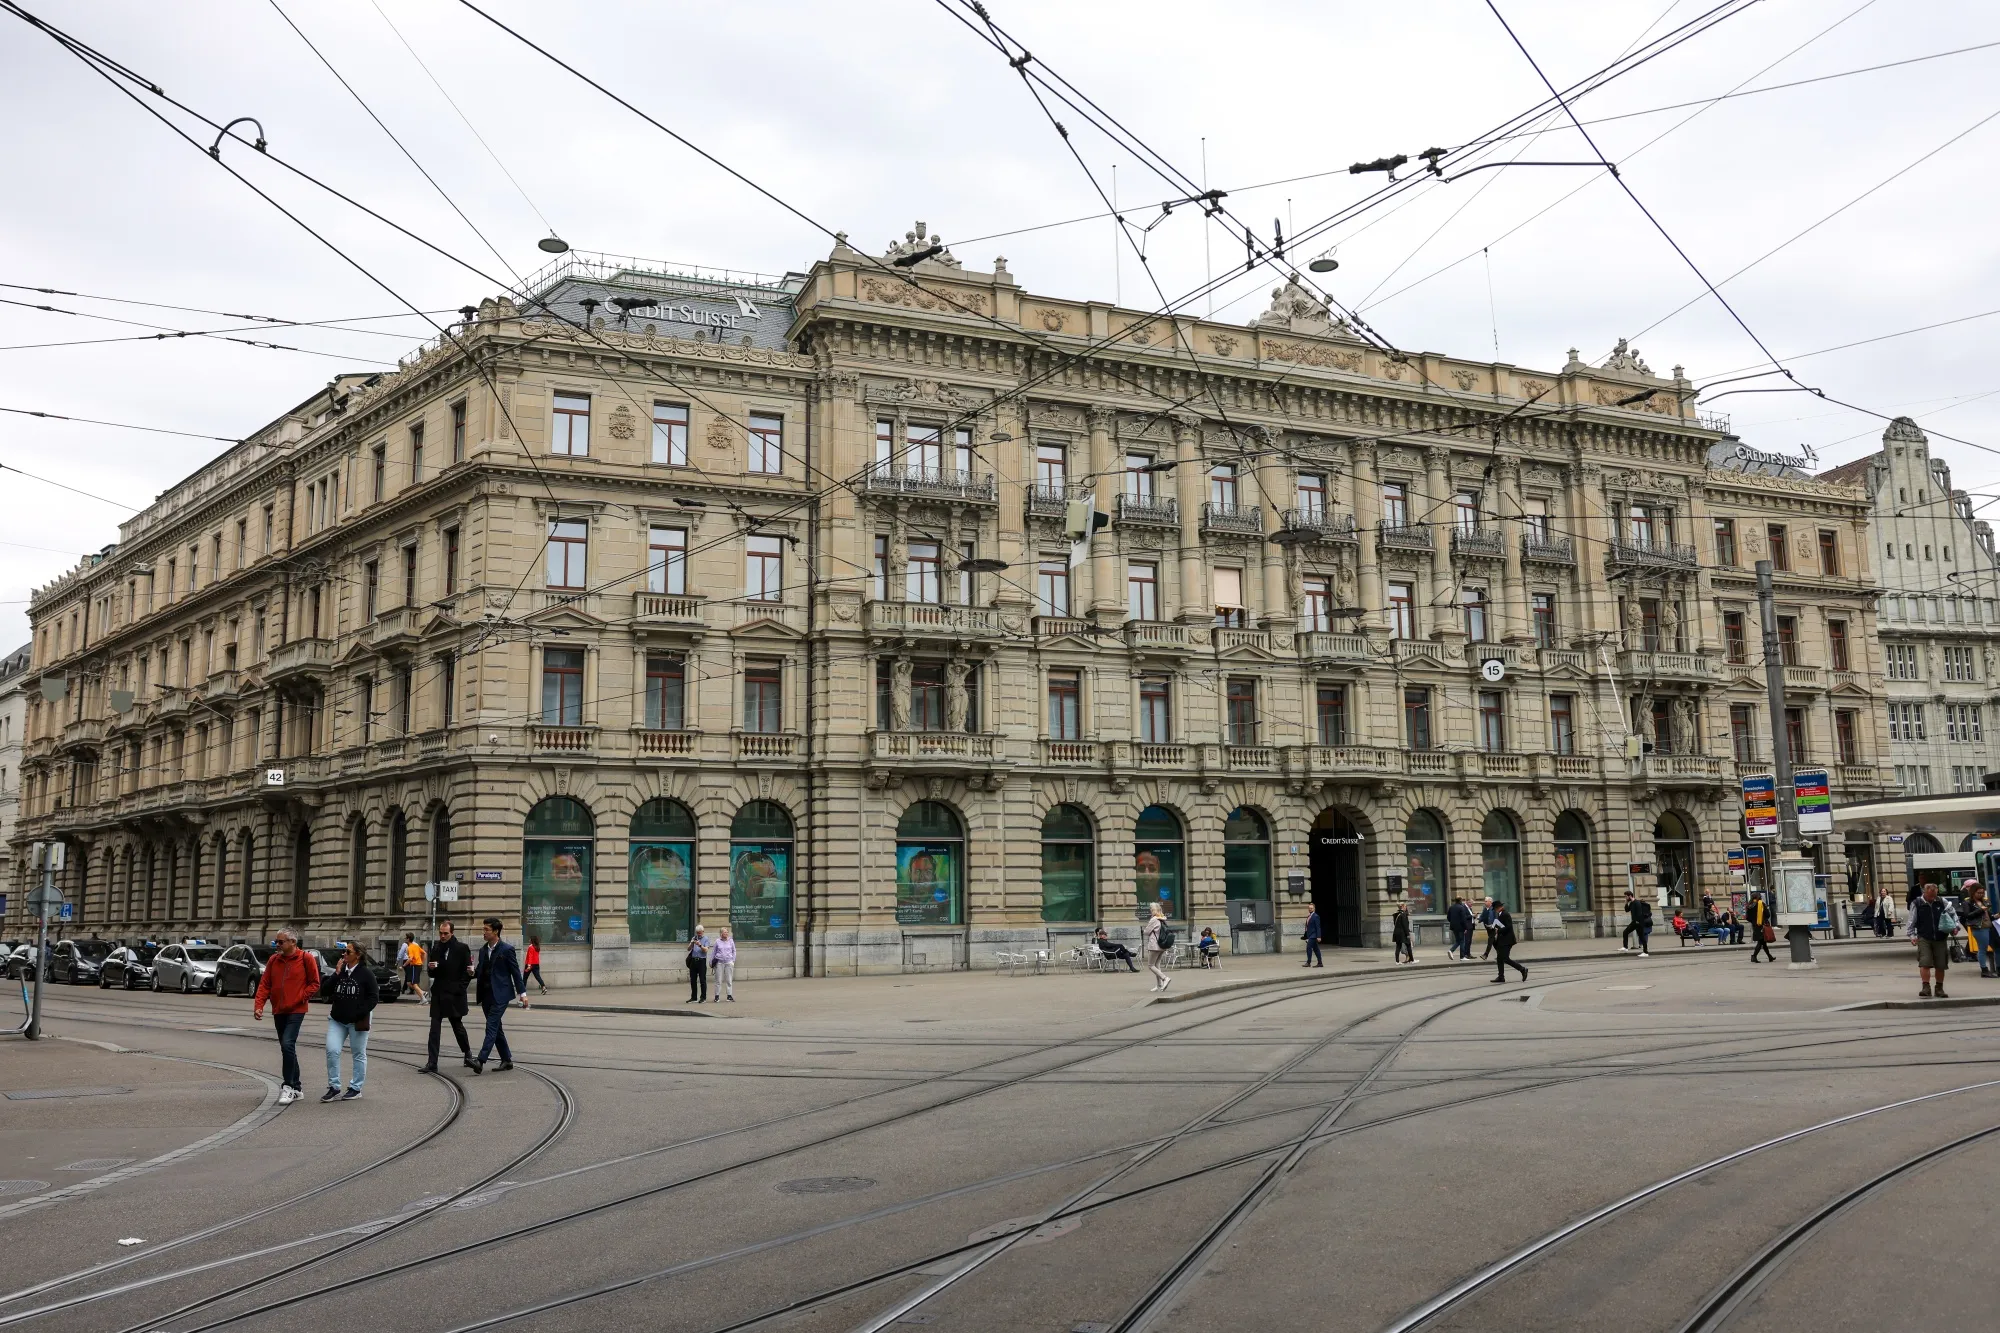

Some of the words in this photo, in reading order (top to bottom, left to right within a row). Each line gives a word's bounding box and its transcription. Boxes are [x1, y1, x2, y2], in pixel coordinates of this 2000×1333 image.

[679, 304, 740, 329] SUISSE
[1735, 446, 1774, 463] CREDIT
[1486, 665, 1500, 676] 15
[269, 773, 282, 782] 42
[1321, 837, 1341, 845] CREDIT
[1341, 837, 1359, 845] SUISSE
